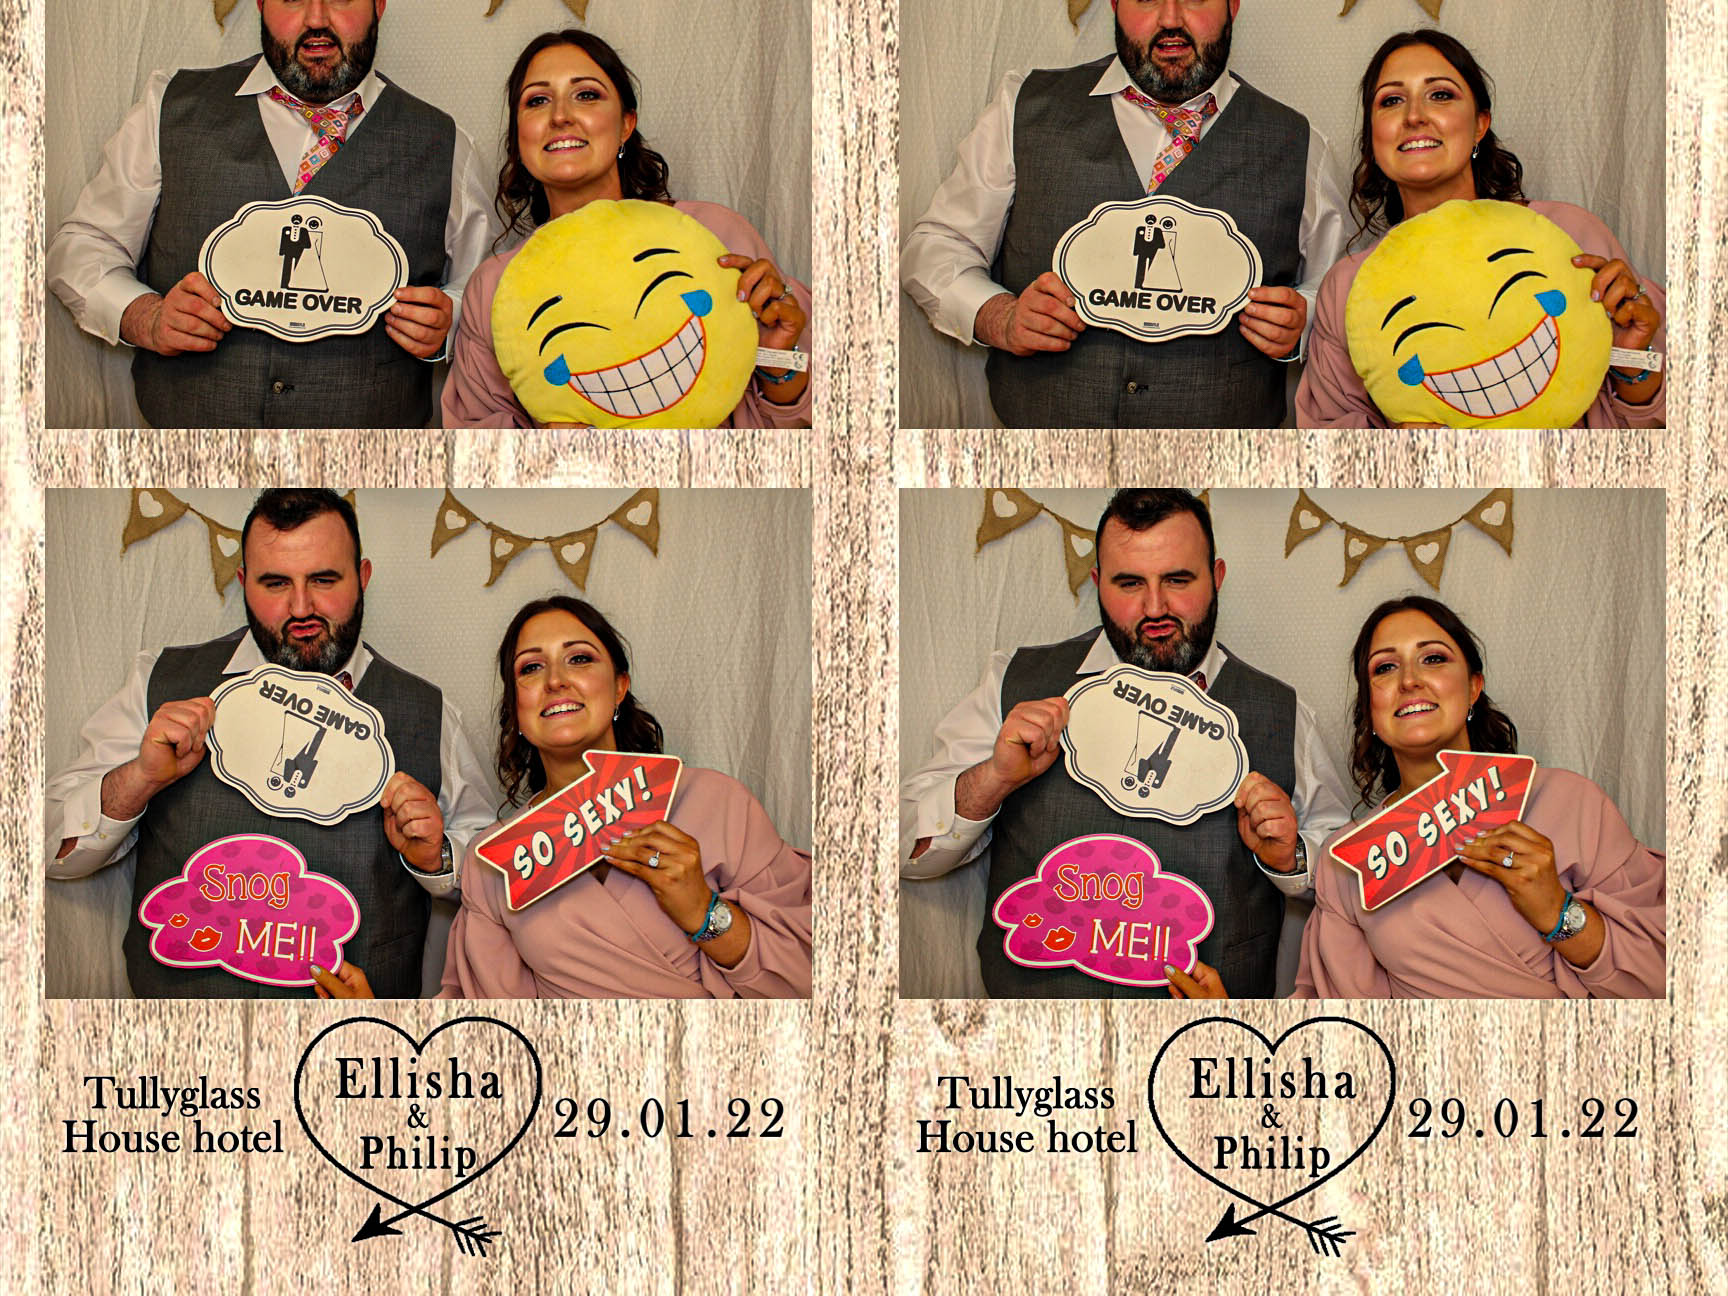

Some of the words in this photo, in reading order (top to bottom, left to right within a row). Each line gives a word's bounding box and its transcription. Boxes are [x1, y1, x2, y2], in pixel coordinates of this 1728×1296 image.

[234, 288, 298, 309] GAME
[302, 293, 362, 314] OVER
[1088, 288, 1152, 309] GAME
[1156, 293, 1216, 314] OVER
[259, 680, 313, 715] OVER
[1113, 680, 1167, 715] OVER
[313, 705, 371, 741] GAME
[1167, 705, 1225, 741] GAME
[513, 830, 554, 879] SO
[563, 765, 652, 847] SEXY!
[1367, 830, 1408, 879] SO
[1417, 765, 1506, 847] SEXY!
[200, 863, 290, 909] Snog
[1054, 863, 1144, 909] Snog
[235, 918, 317, 962] ME!!
[1089, 918, 1171, 962] ME!!
